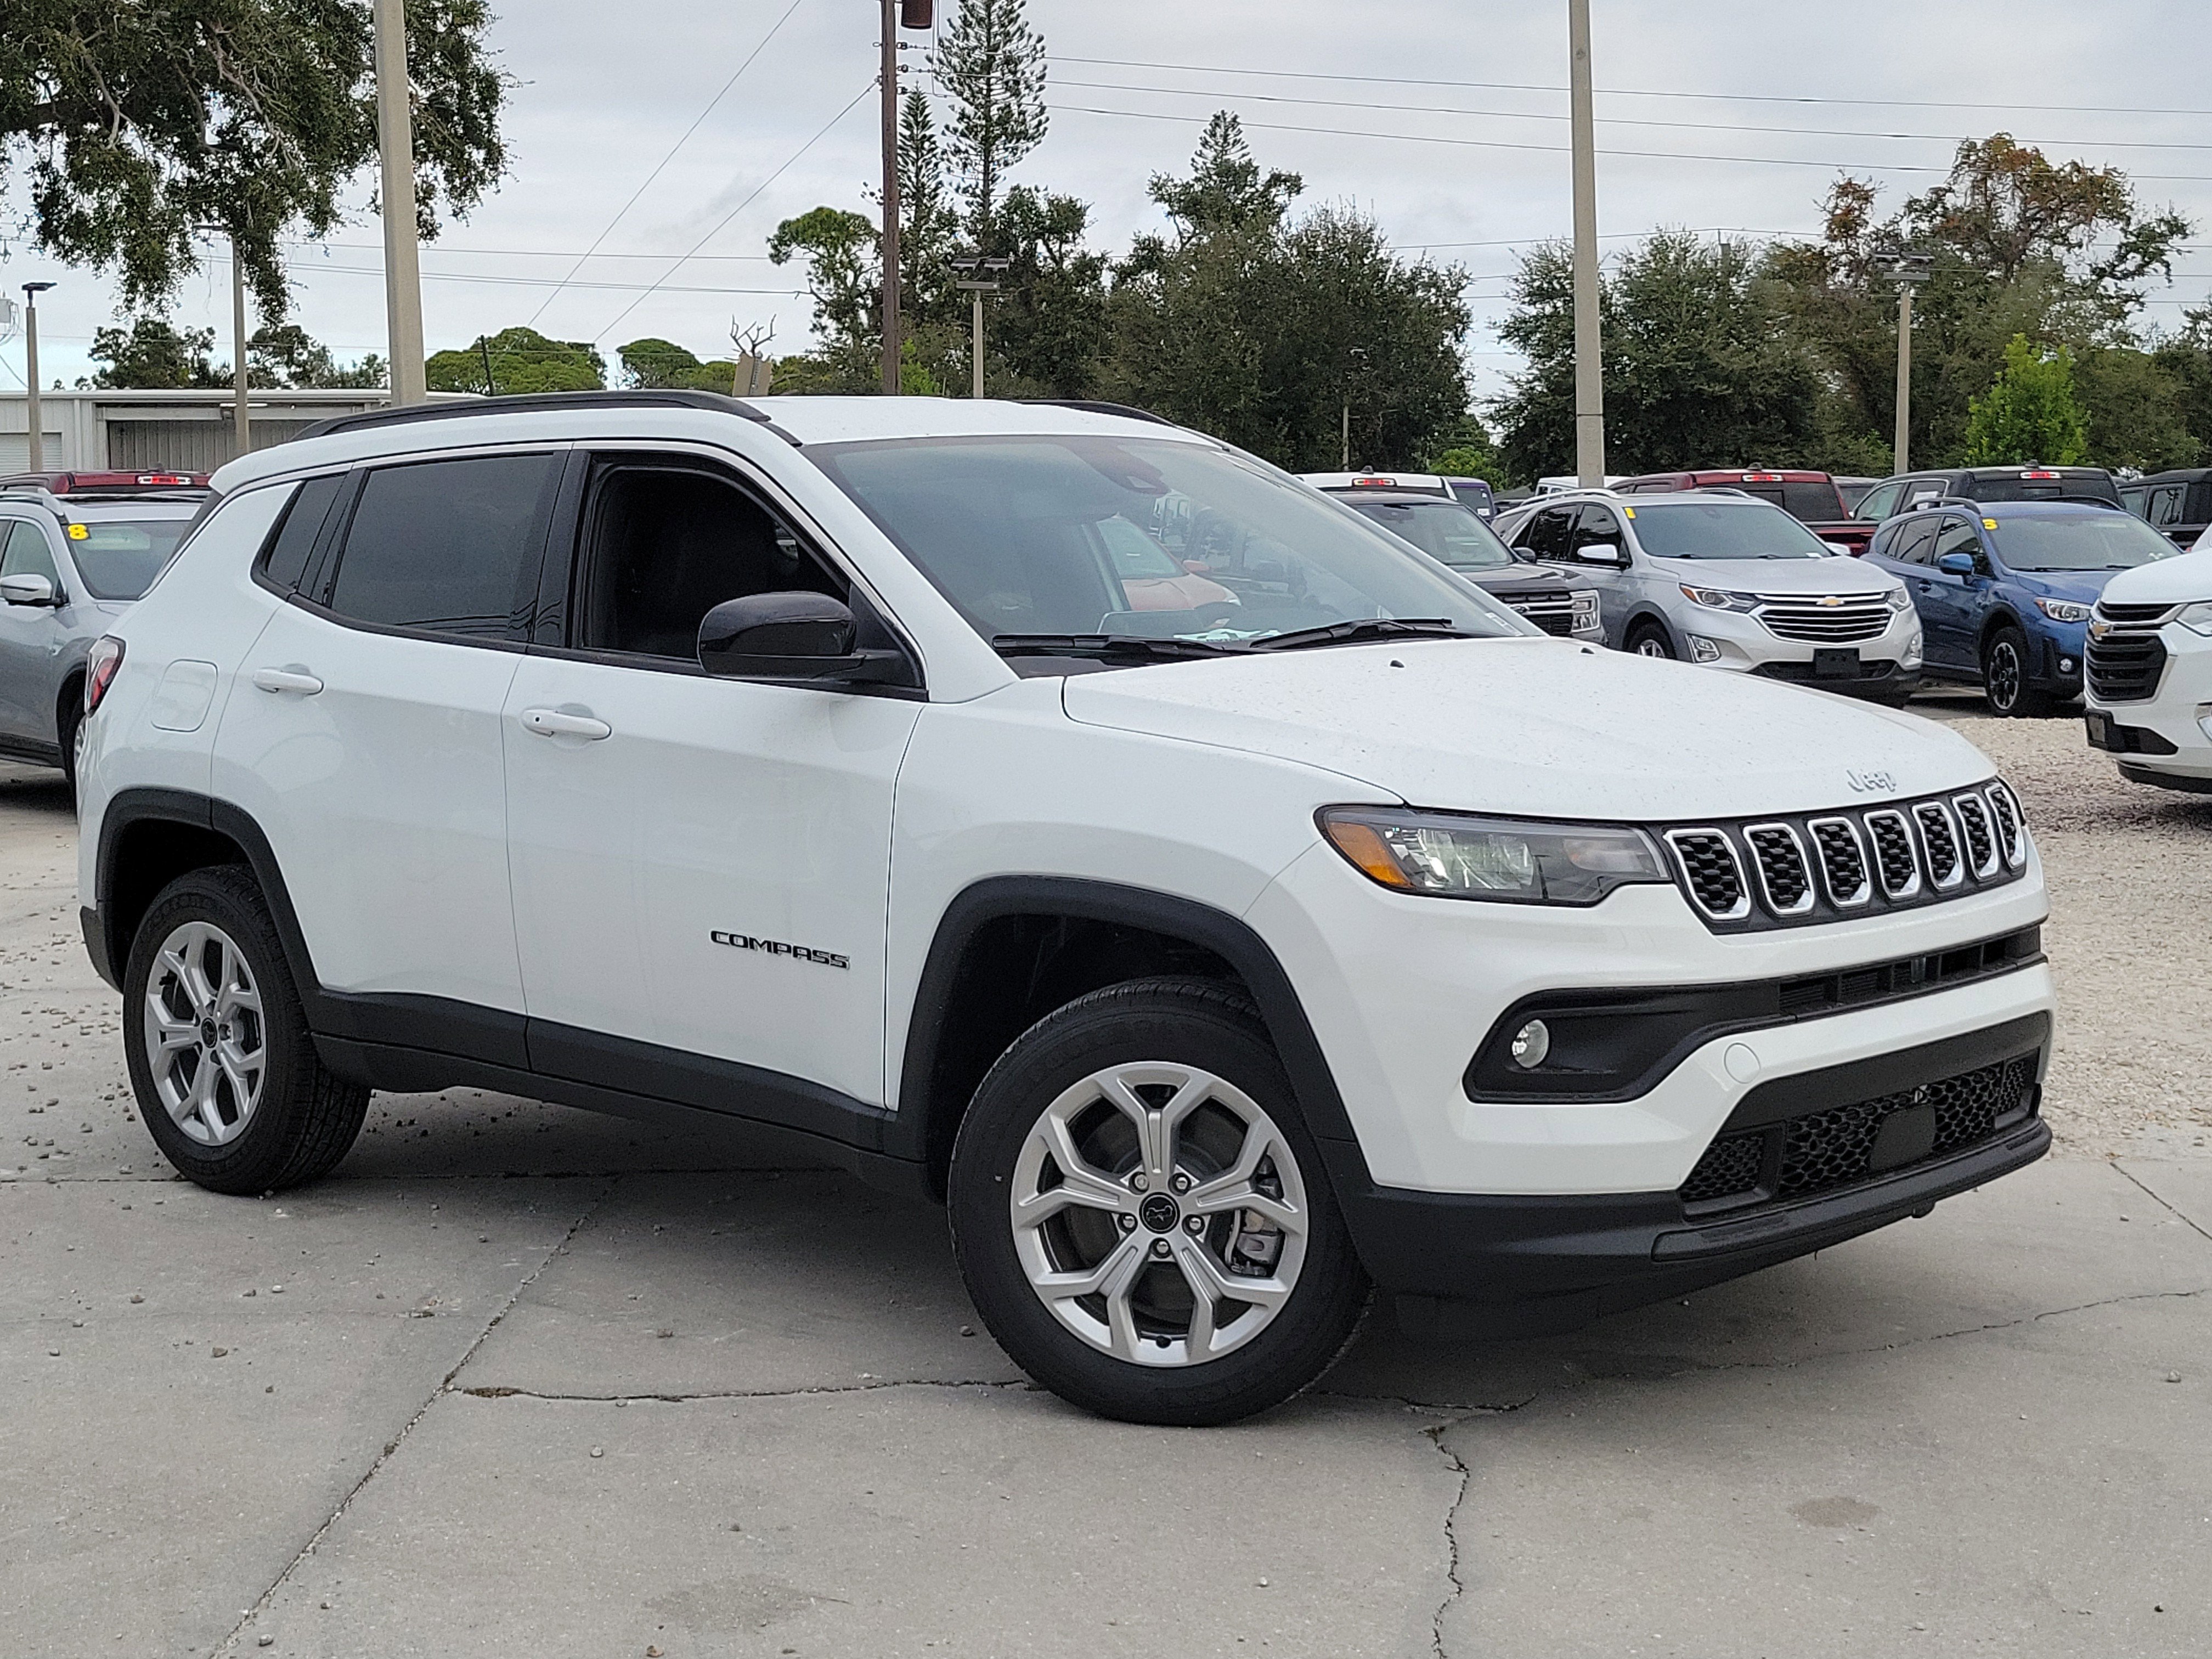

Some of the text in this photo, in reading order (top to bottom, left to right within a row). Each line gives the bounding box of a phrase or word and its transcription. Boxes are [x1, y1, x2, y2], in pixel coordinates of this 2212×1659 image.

[67, 524, 89, 540] 8
[1982, 518, 1998, 530] 3
[1846, 769, 1897, 792] Jeep
[710, 930, 850, 969] COMPASS
